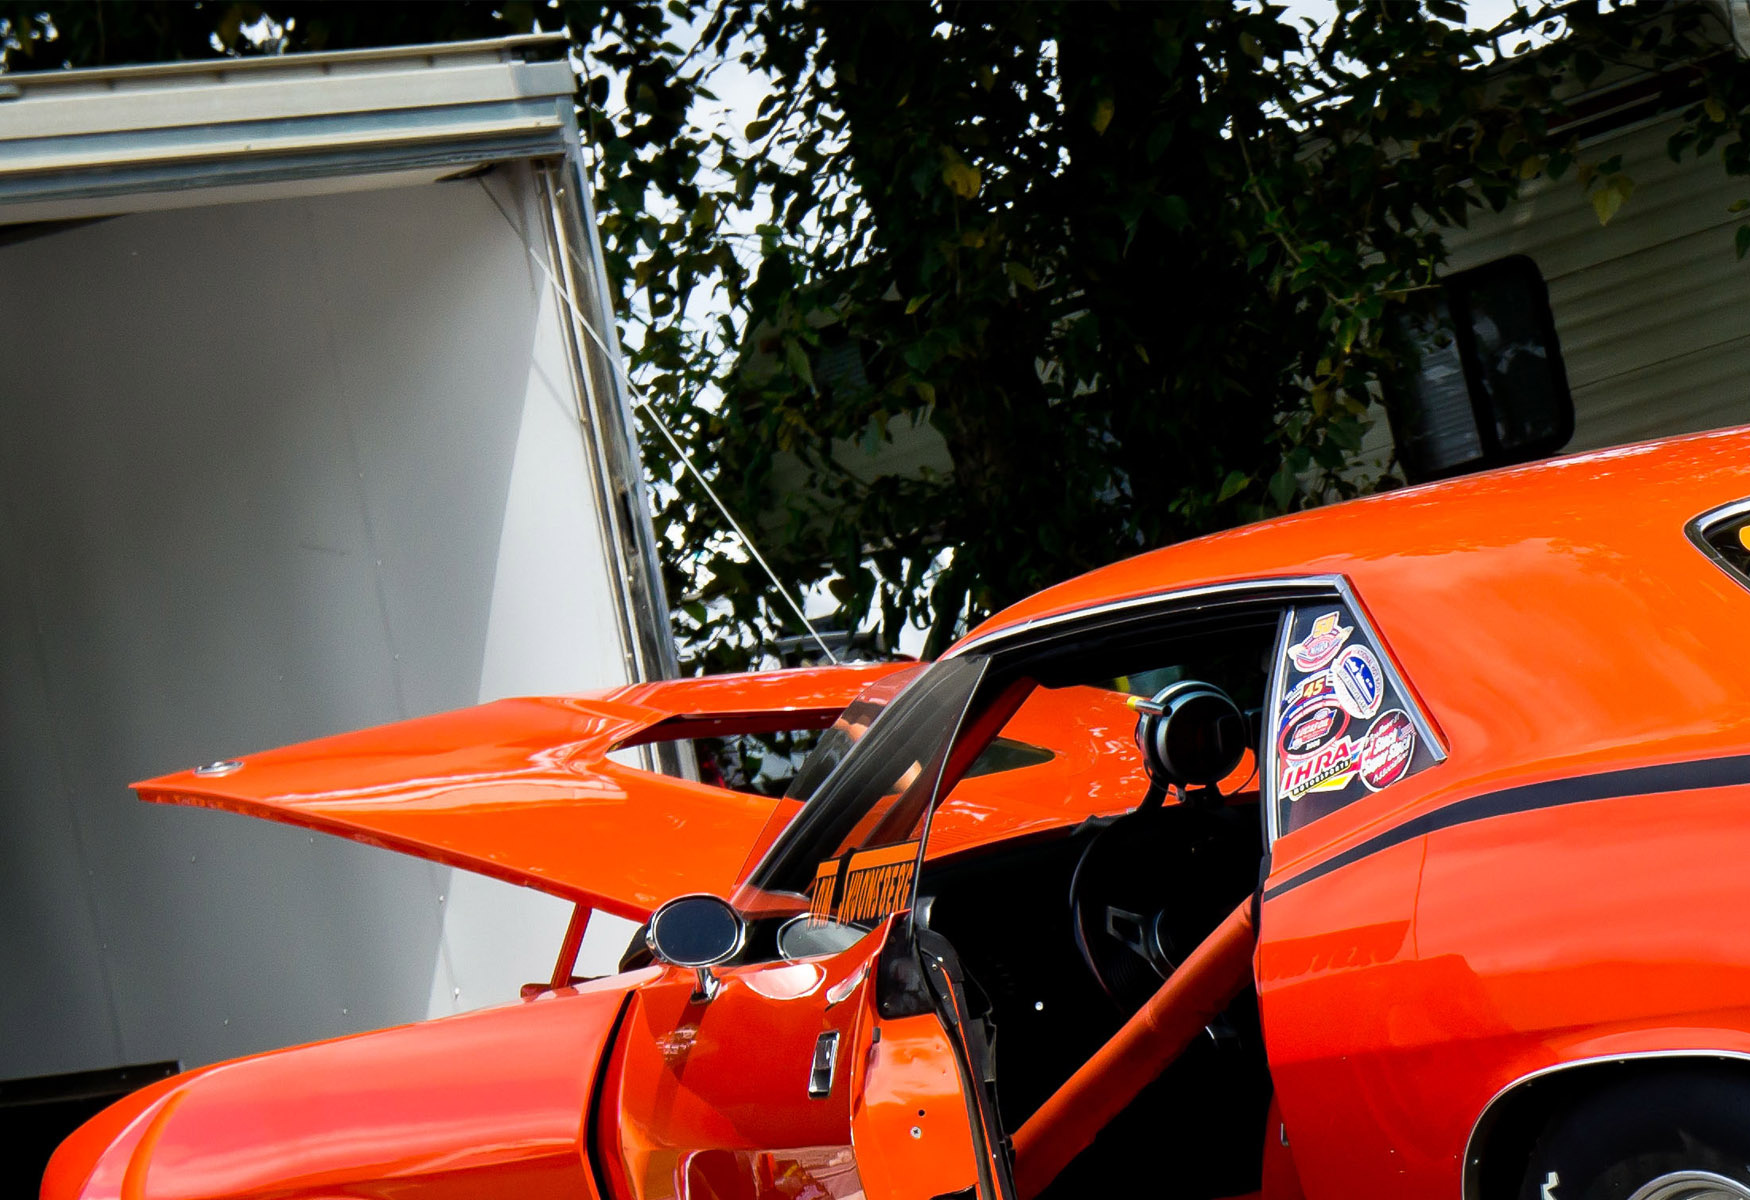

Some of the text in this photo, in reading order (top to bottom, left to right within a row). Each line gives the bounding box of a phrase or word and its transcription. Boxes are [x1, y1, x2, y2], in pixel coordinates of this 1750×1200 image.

[1303, 677, 1325, 698] 45
[1285, 742, 1350, 790] IHRA
[1292, 761, 1350, 796] MOTORSPORTS
